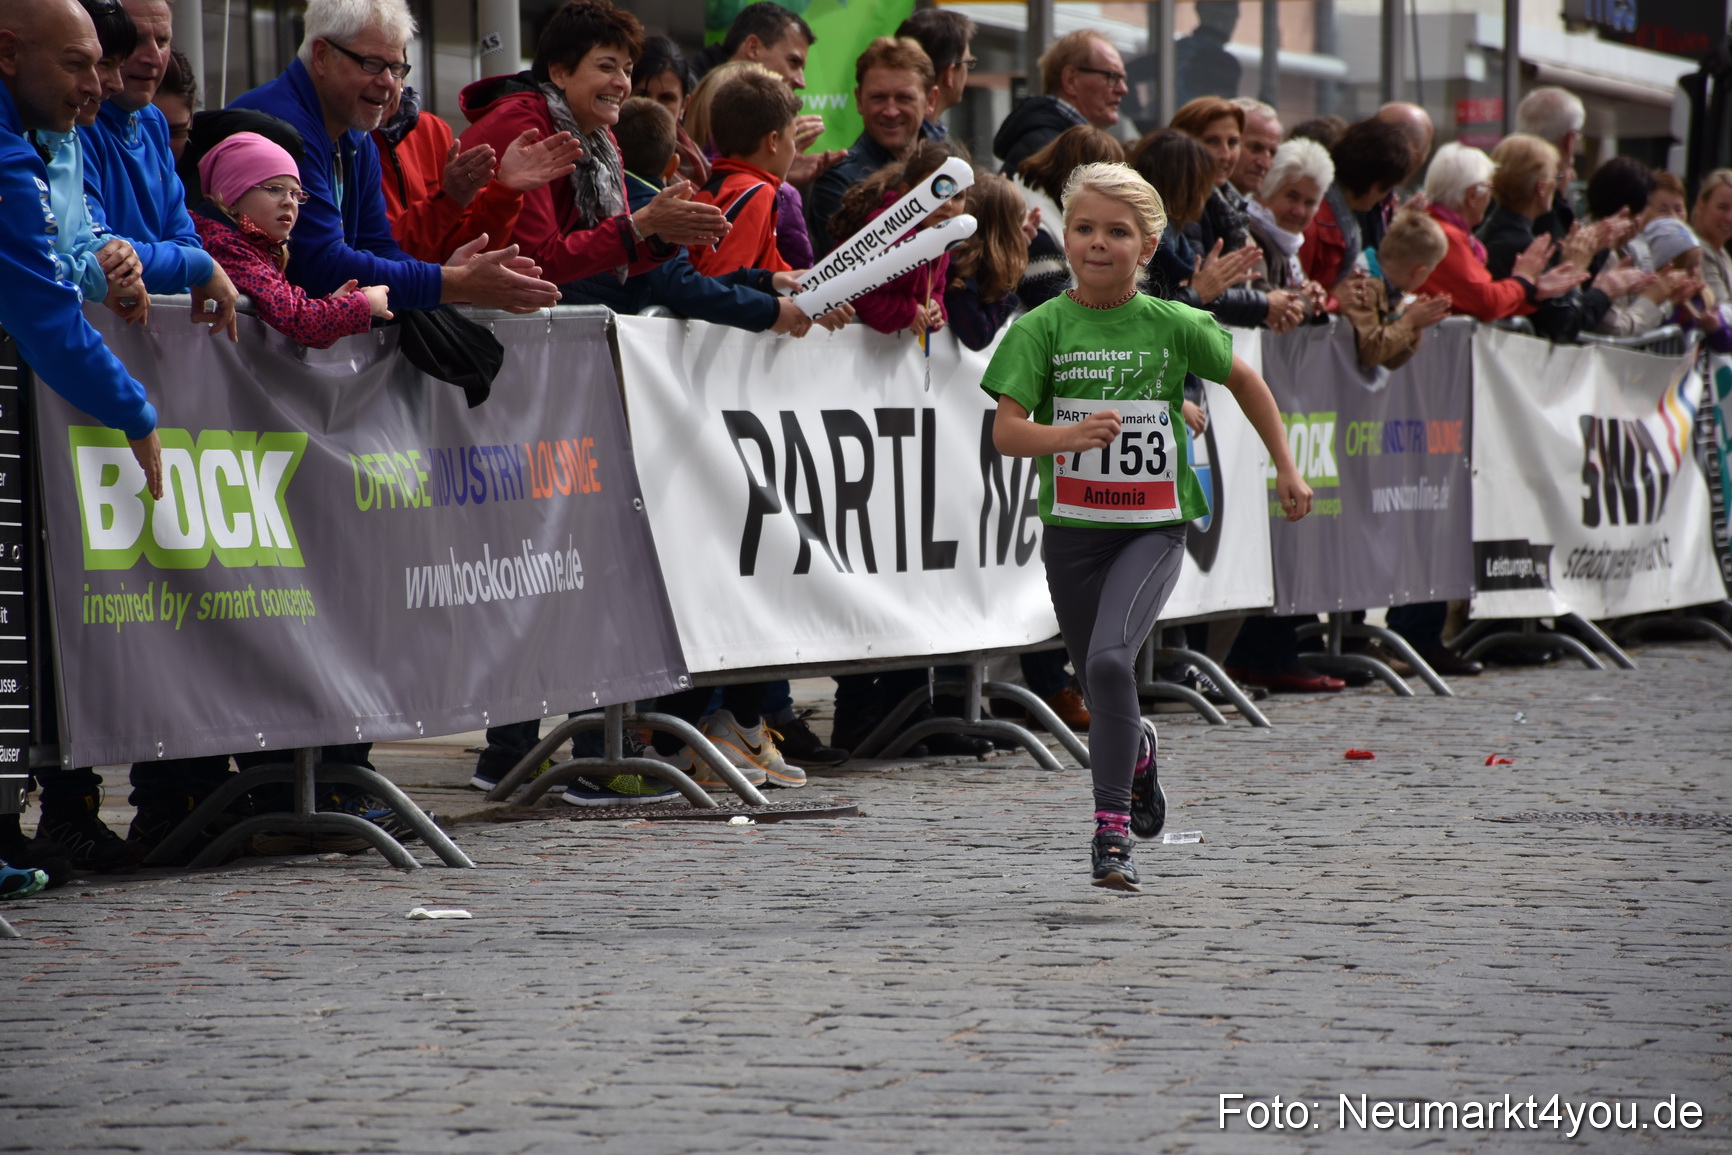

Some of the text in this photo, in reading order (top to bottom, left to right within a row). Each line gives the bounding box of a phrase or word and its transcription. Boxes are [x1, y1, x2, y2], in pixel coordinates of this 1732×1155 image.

[1052, 349, 1133, 366] Neumarkter
[1155, 348, 1170, 399] BAMBI
[1056, 409, 1157, 425] PART umarkt
[76, 444, 296, 551] BOCK
[347, 436, 602, 512] OFFICE INDUSTRY LOUNGE
[721, 408, 959, 577] PARTL
[1083, 486, 1146, 506] Antonia
[405, 533, 584, 610] www.bockonline.de
[83, 581, 316, 633] inspired by smart concepts
[577, 776, 600, 791] Reebok
